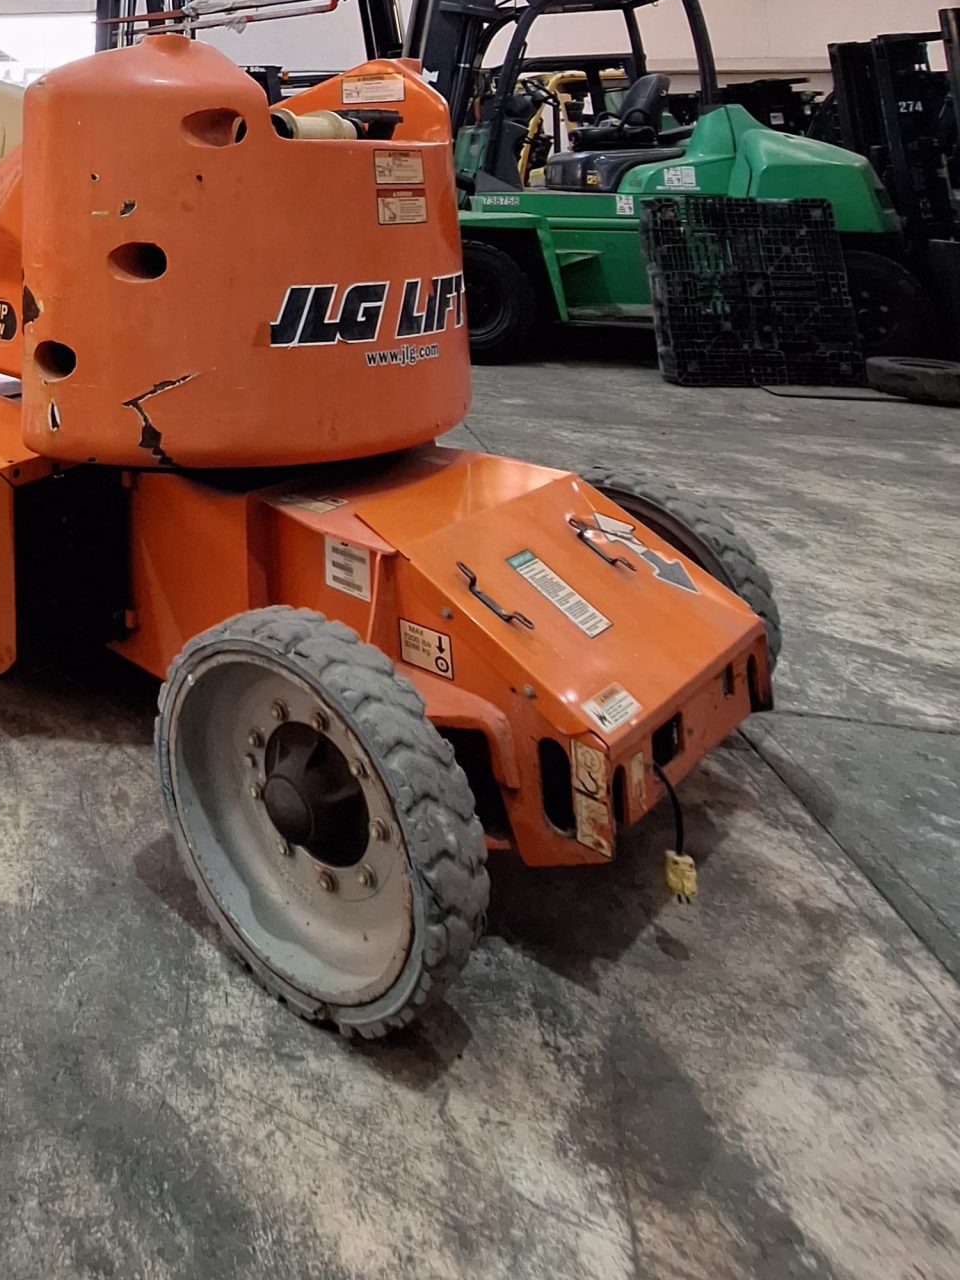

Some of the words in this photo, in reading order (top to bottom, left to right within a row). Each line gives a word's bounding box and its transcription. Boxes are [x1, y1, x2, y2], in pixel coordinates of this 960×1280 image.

[898, 101, 923, 113] 274
[270, 281, 390, 348] JLG
[395, 271, 466, 340] LIFT
[365, 343, 440, 368] www.jlg.com
